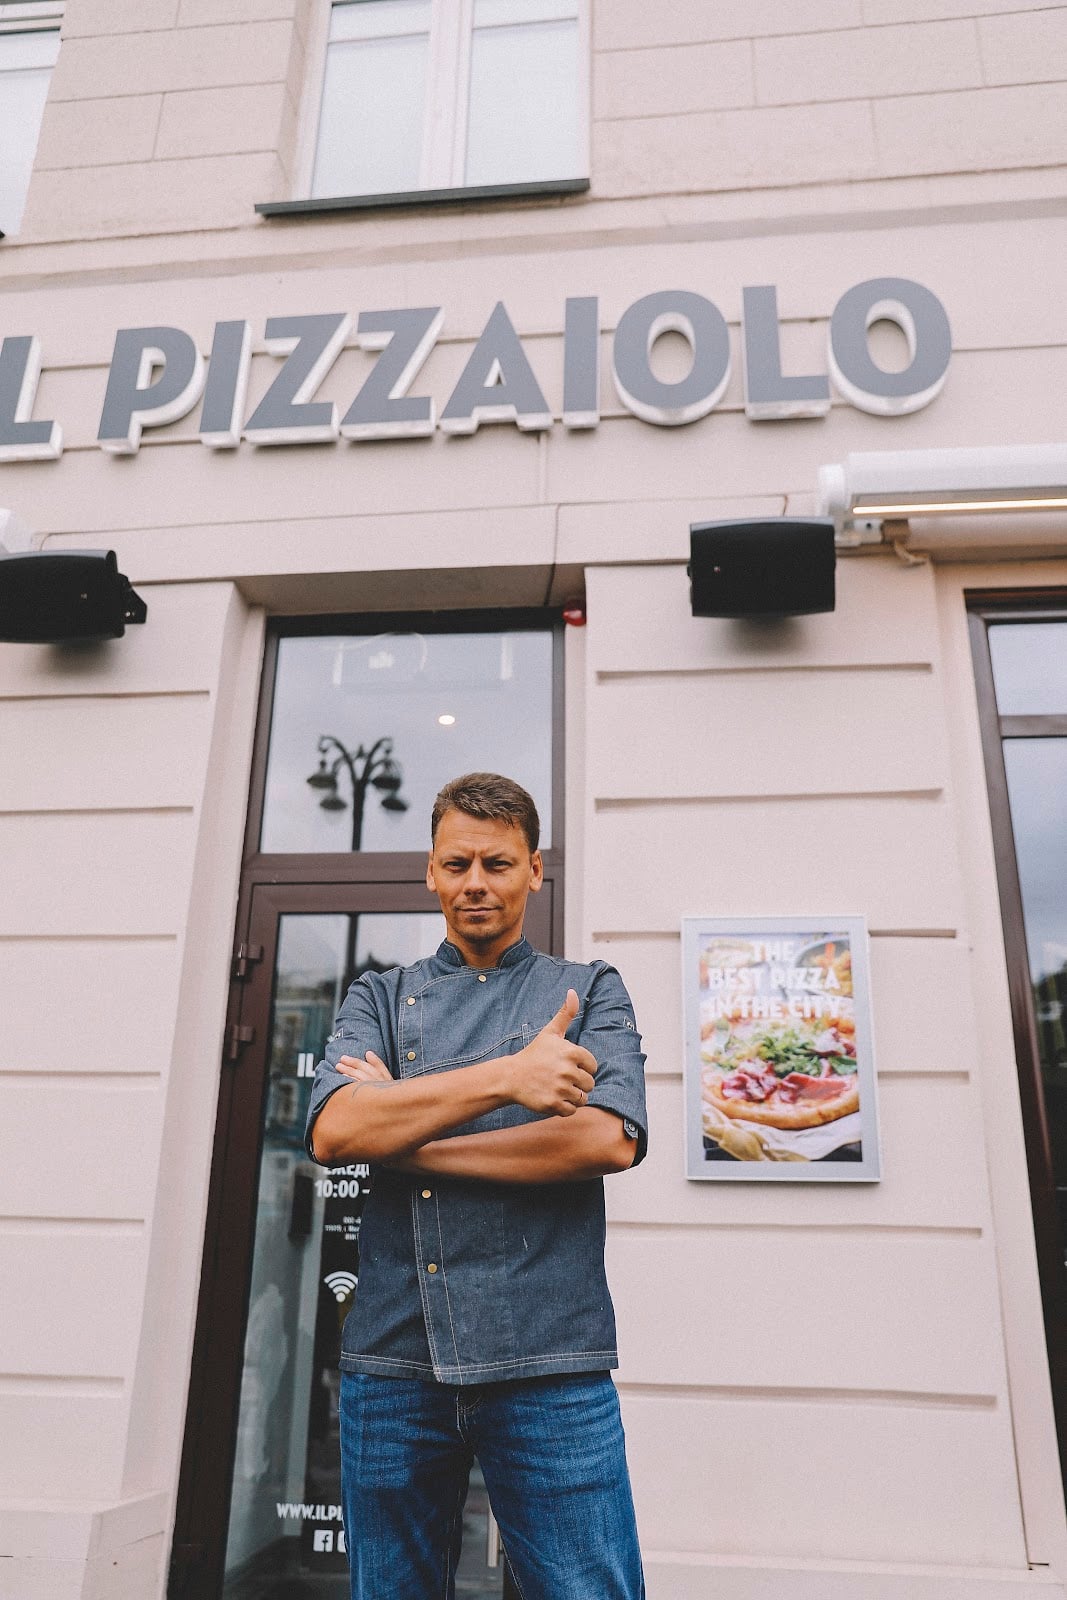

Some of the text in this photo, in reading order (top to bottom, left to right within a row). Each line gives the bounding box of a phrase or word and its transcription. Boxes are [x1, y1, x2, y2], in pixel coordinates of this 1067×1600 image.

[97, 277, 952, 456] PIZZAIOLO
[751, 940, 795, 962] THE
[708, 967, 841, 990] BEST PIZZA
[709, 996, 841, 1018] IN THE CITY
[297, 1053, 315, 1078] IL
[314, 1180, 360, 1198] 10:00
